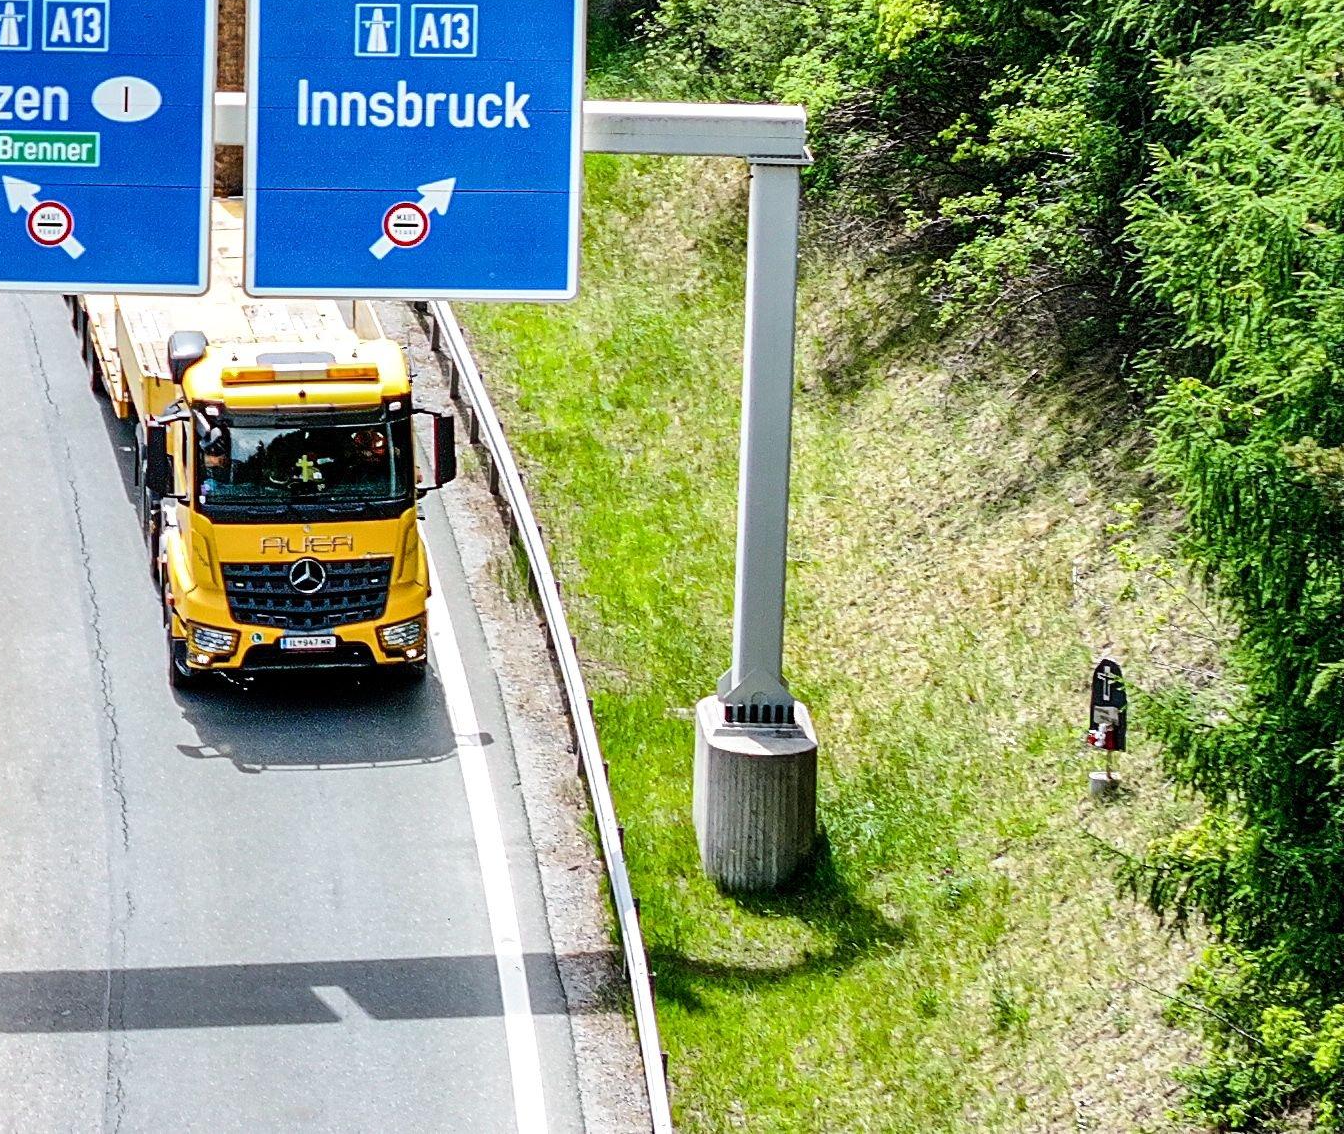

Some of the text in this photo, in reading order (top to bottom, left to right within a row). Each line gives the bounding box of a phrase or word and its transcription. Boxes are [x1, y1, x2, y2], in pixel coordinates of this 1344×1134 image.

[50, 7, 101, 44] A13
[418, 12, 470, 49] A13
[297, 78, 532, 129] Innsbruck
